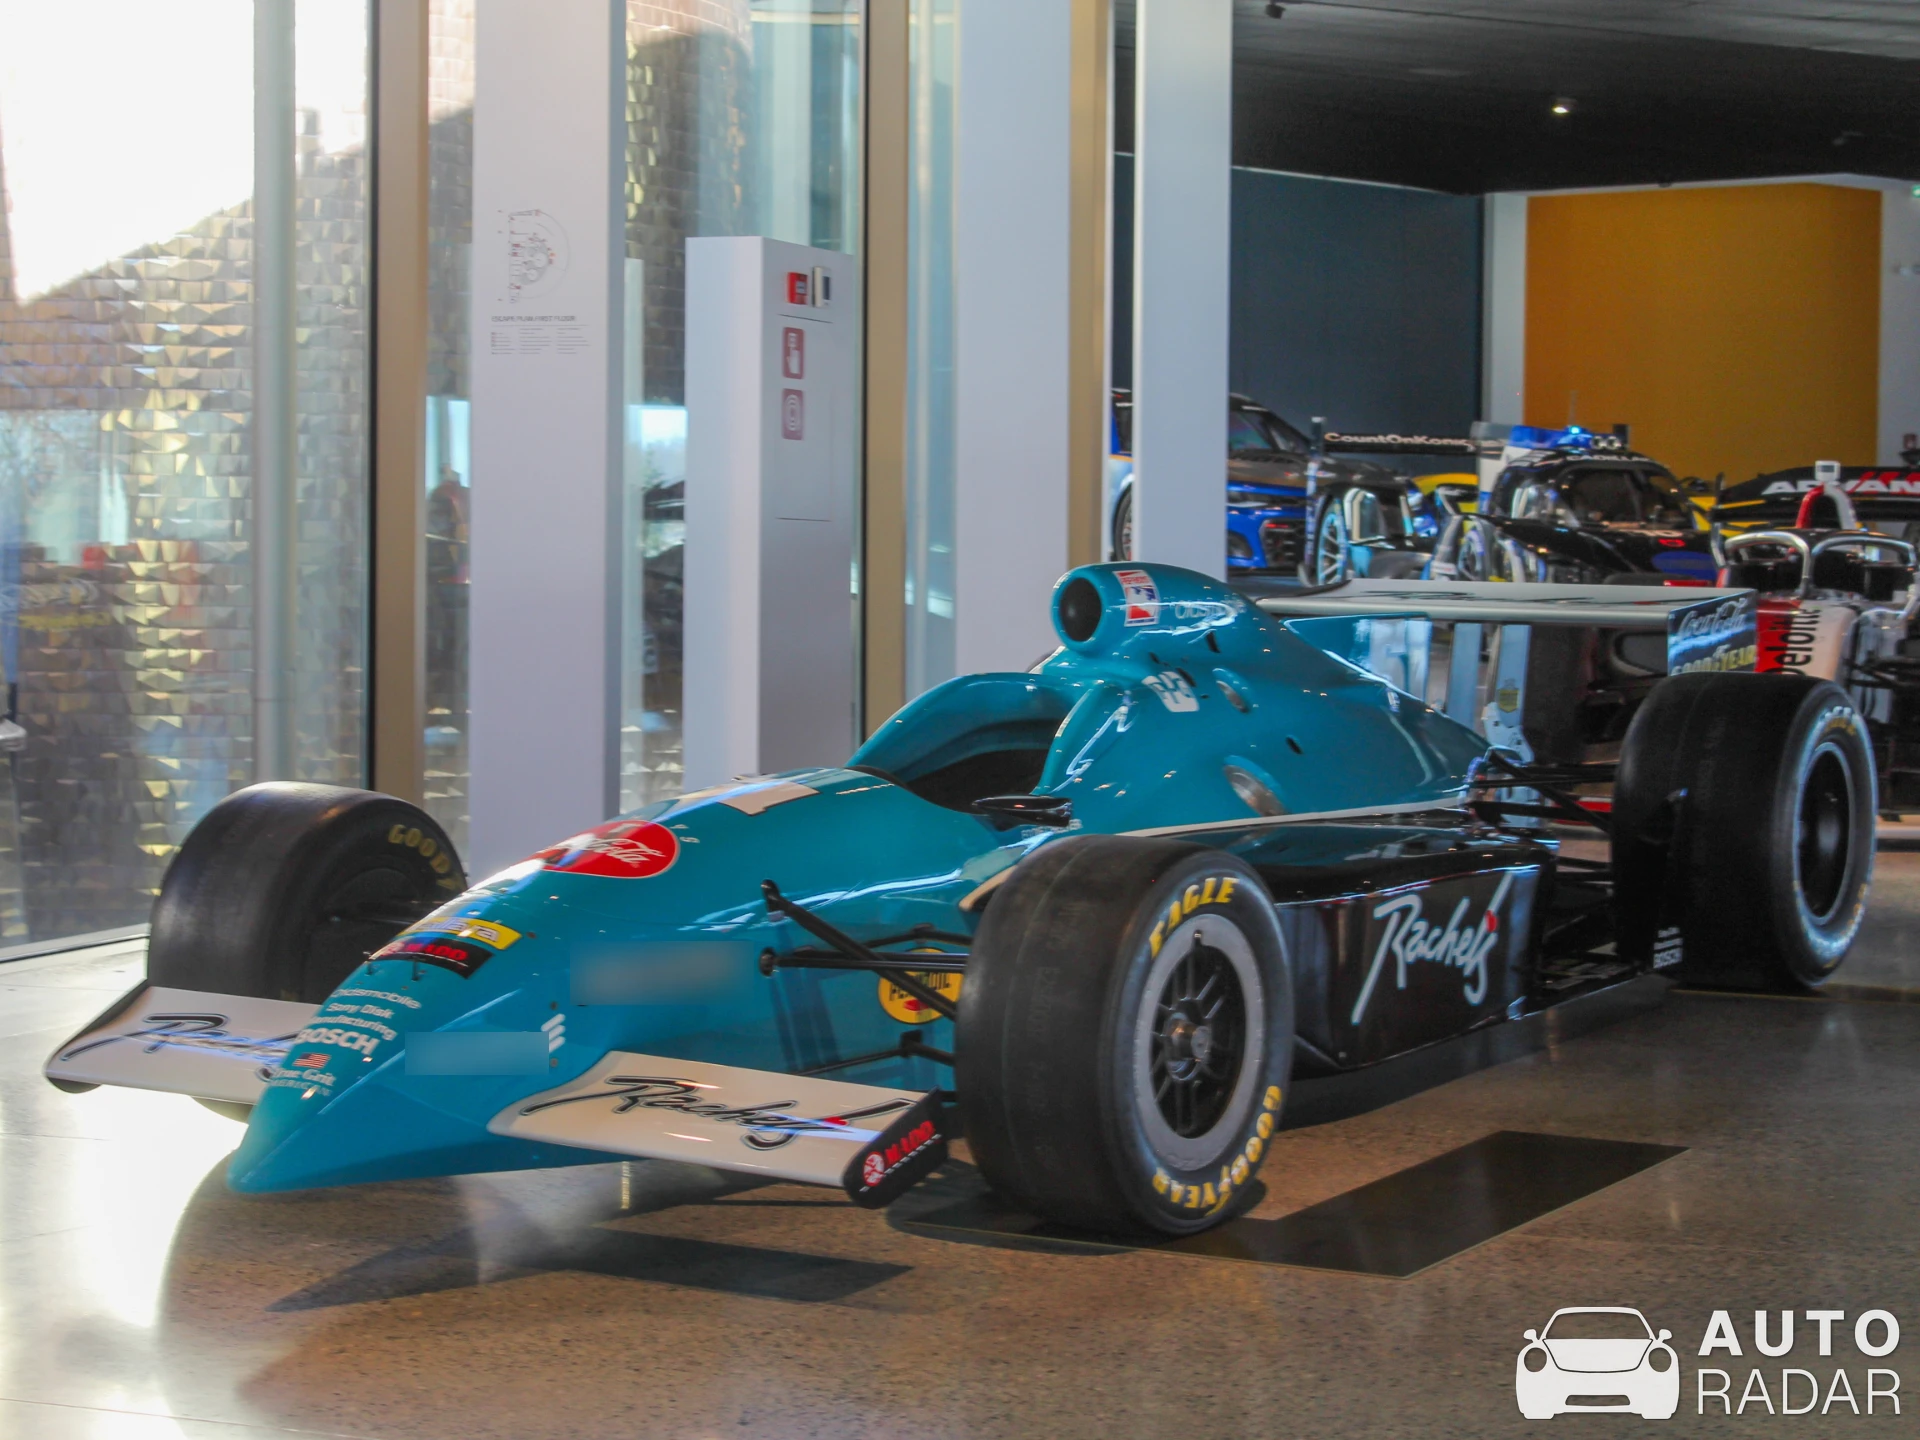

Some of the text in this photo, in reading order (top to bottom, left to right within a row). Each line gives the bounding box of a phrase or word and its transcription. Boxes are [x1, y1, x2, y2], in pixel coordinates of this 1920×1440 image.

[1764, 606, 1822, 674] eloitte
[1149, 877, 1240, 959] EAGLE
[296, 1027, 381, 1056] BOSCH
[1152, 1085, 1283, 1217] GOODYEAR
